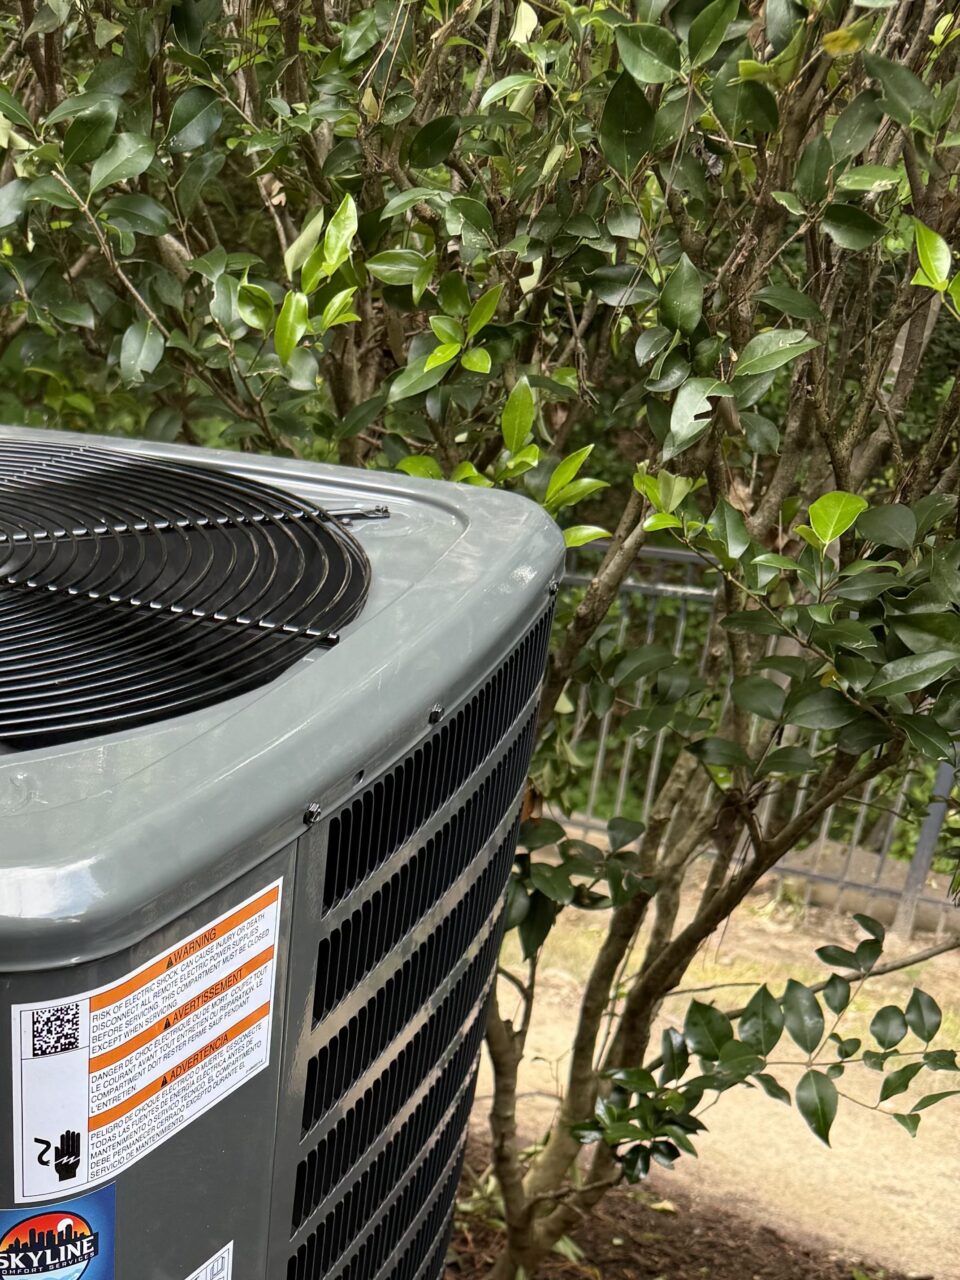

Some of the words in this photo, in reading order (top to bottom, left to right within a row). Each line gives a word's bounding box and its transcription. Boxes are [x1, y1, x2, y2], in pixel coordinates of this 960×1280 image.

[92, 1008, 111, 1023] RISK
[113, 1002, 124, 1016] OF
[125, 982, 156, 1008] ELECTRIC
[181, 960, 194, 972] CAN
[195, 947, 214, 964] CAUSE
[215, 933, 235, 950] INJURY
[236, 925, 246, 936] OR
[247, 914, 265, 931] DEATH
[174, 928, 217, 962] WARNING
[92, 1005, 139, 1034] DISCONNECT
[141, 997, 151, 1009] ALL
[152, 980, 178, 1000] REMOTE
[180, 962, 209, 984] ELECTRIC
[210, 947, 231, 964] POWER
[232, 926, 259, 950] SUPPLIES
[92, 1025, 123, 1044] BEFORE
[162, 989, 176, 1004] THIS
[177, 960, 222, 998] COMPARTMENT
[222, 950, 238, 966] MUST
[239, 946, 247, 956] BE
[248, 929, 269, 949] CLOSED
[173, 968, 243, 1024] AVERTISSEMENT
[92, 1034, 122, 1054] EXCEPT
[124, 1023, 144, 1039] WHEN
[170, 1033, 229, 1081] ADVERTENCIA
[48, 1252, 95, 1270] SERVICES
